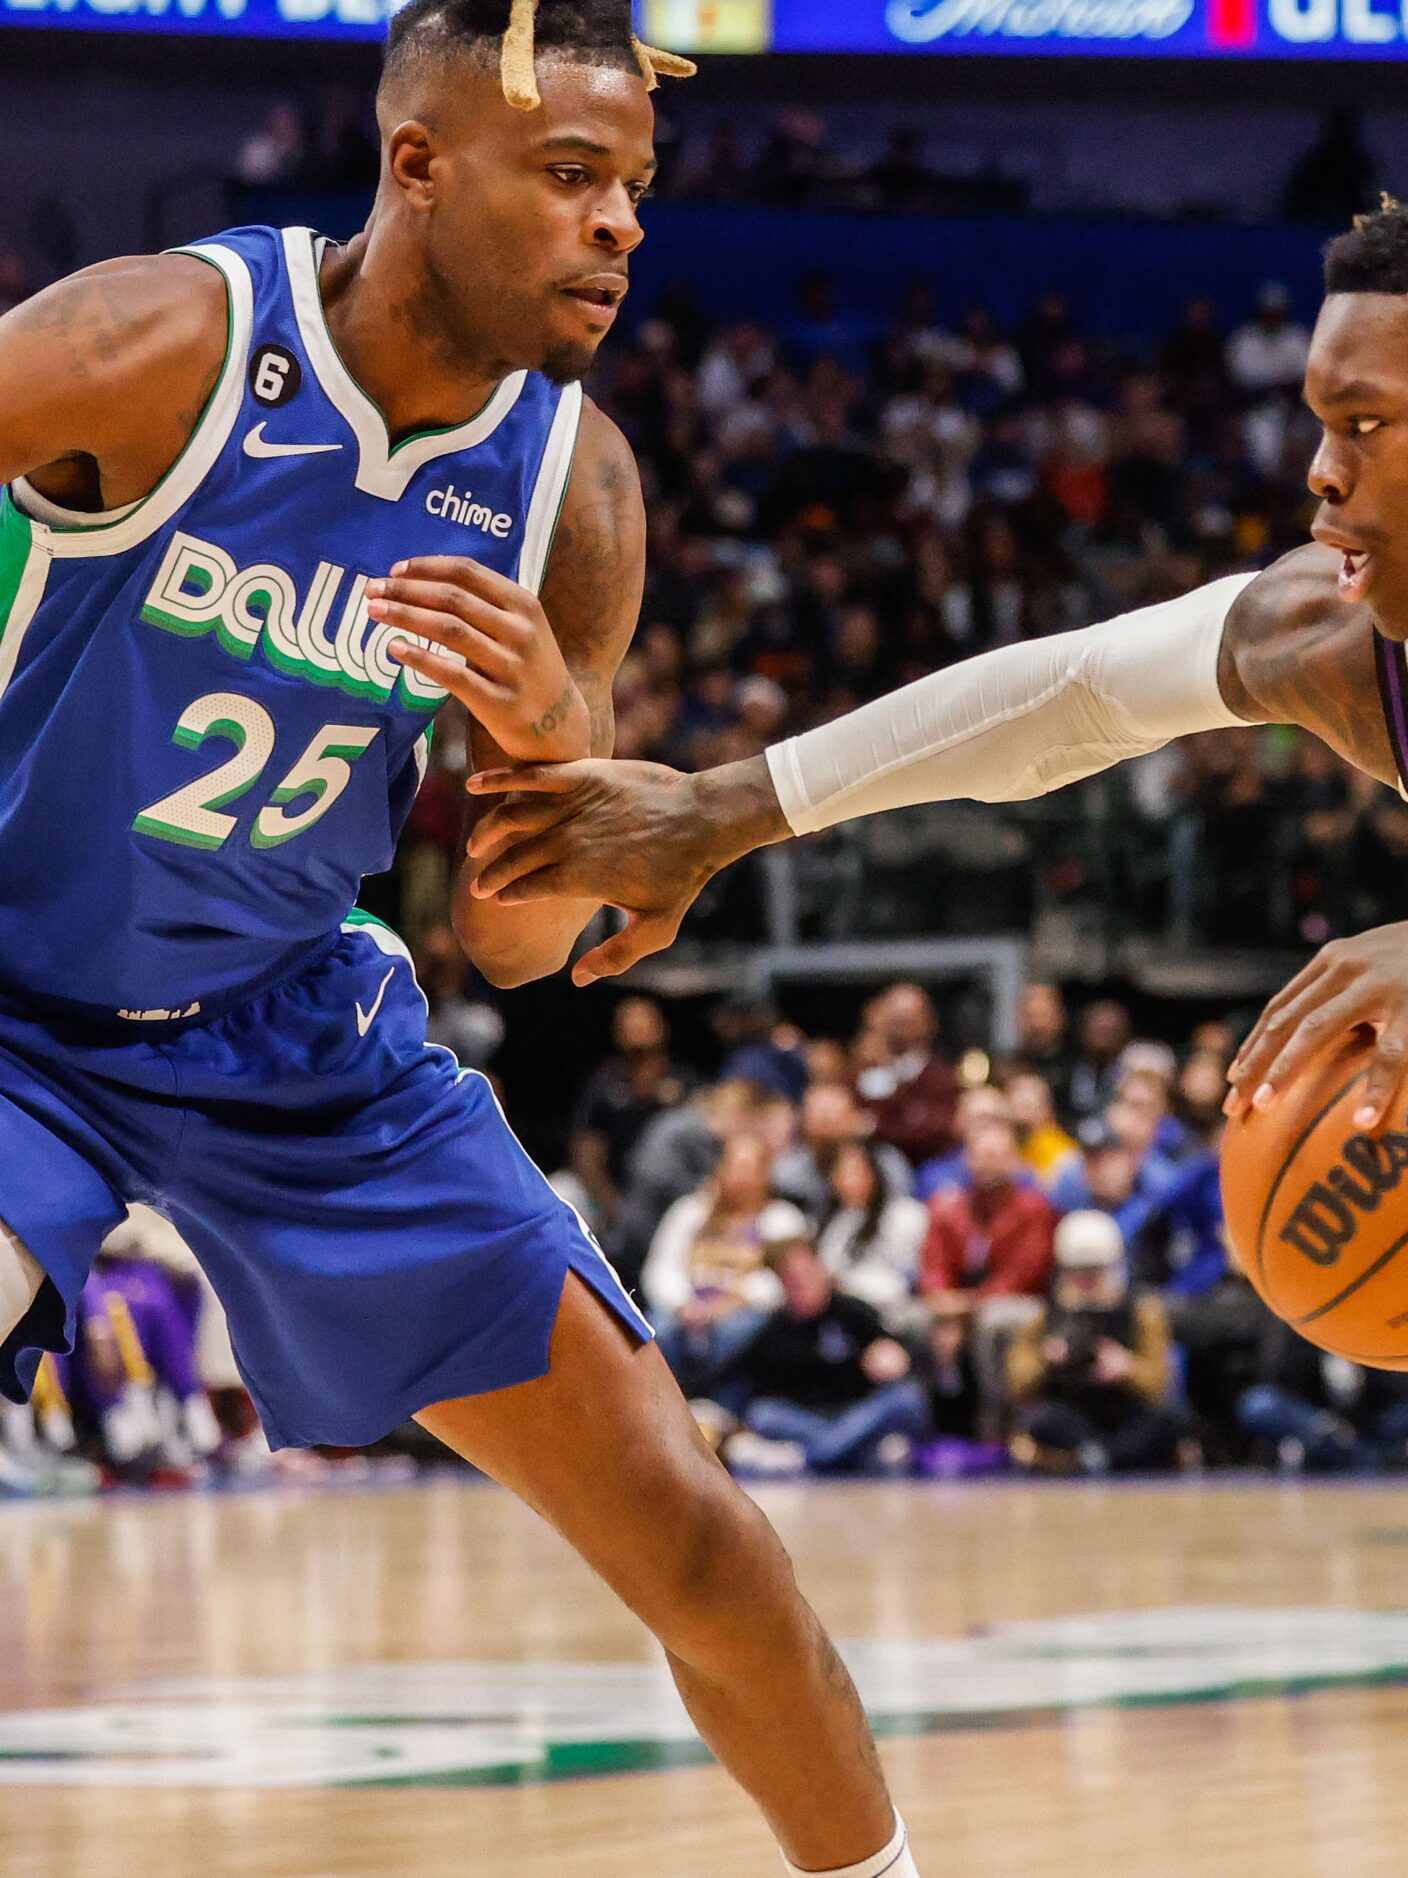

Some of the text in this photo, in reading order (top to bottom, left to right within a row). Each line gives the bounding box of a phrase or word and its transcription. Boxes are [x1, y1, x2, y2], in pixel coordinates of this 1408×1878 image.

[255, 352, 290, 401] 6
[425, 484, 513, 538] chime
[131, 691, 382, 852] 25
